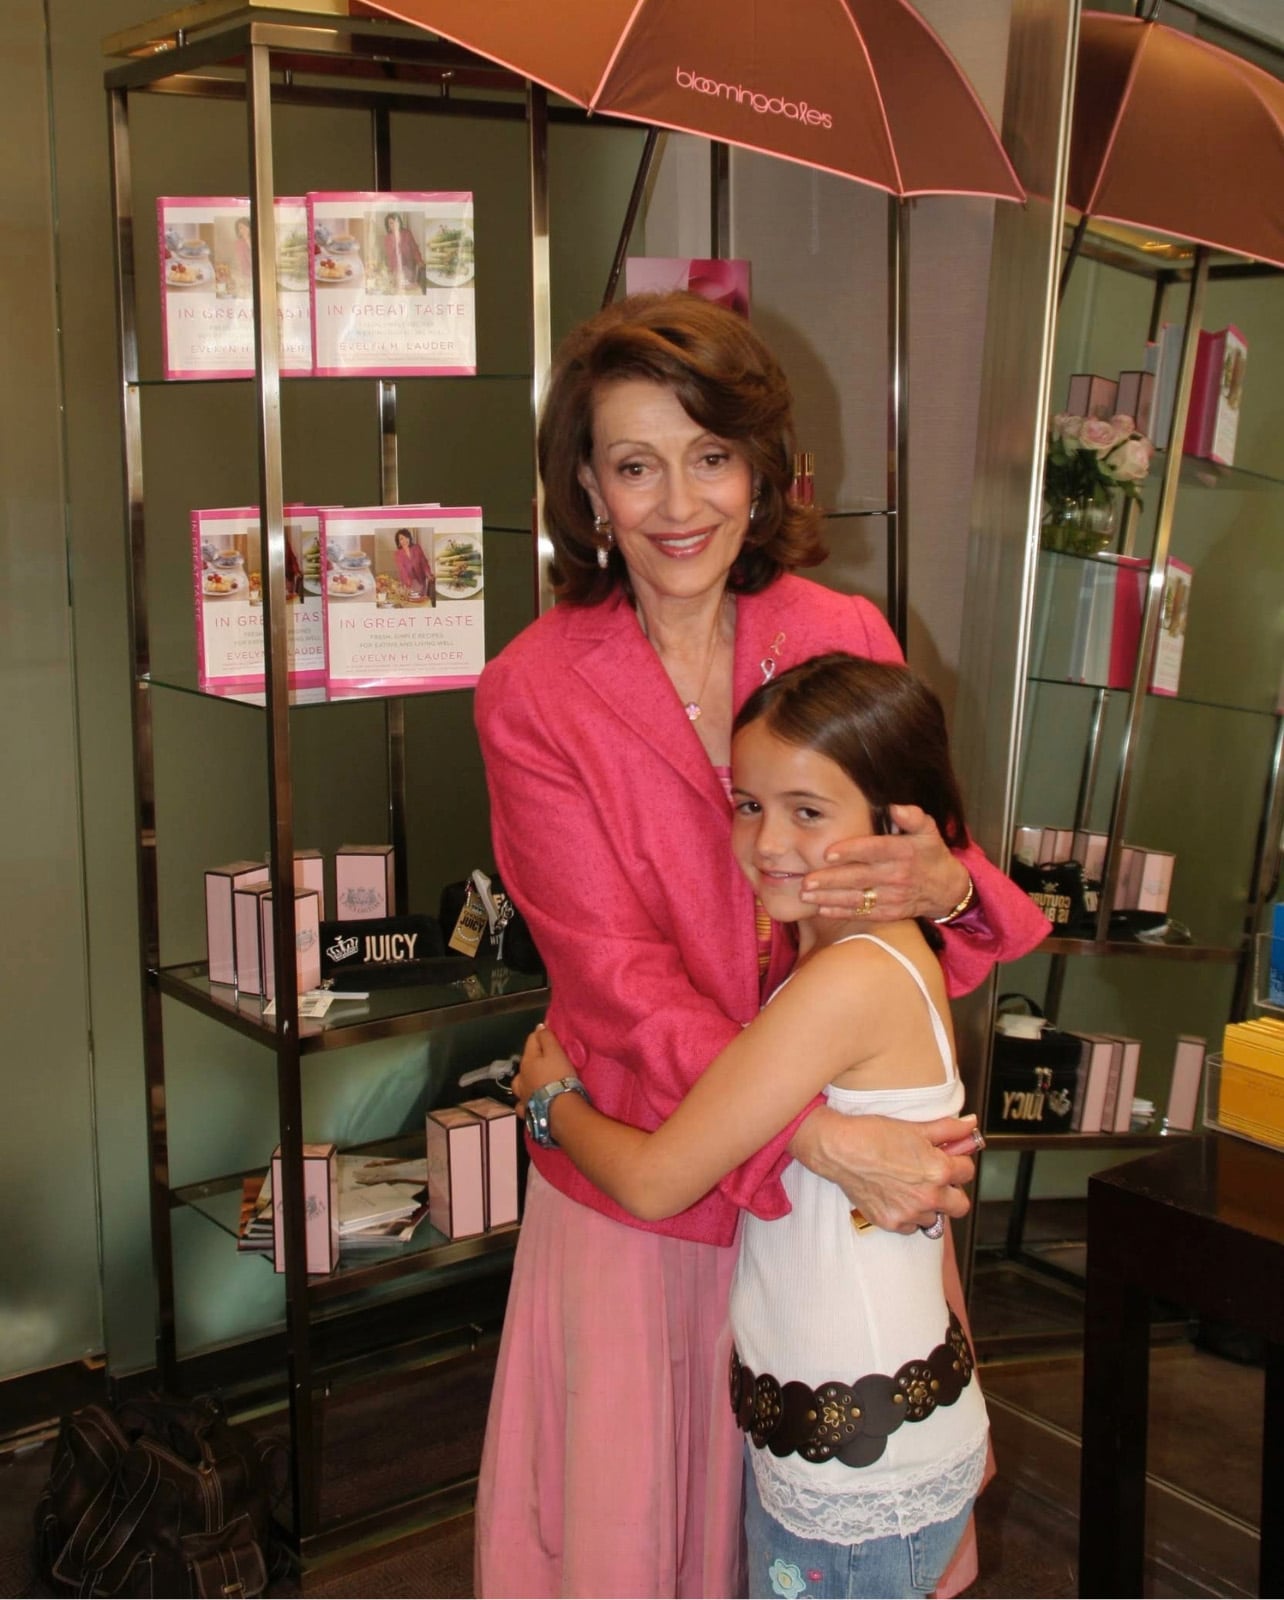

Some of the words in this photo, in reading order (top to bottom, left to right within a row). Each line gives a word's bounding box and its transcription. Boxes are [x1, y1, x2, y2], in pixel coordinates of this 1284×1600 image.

[178, 308, 194, 319] IN
[202, 308, 253, 319] GREA
[327, 304, 343, 316] IN
[352, 304, 405, 316] GREAT
[414, 304, 466, 316] TASTE
[407, 341, 455, 350] LAUDER
[215, 617, 230, 628] IN
[237, 615, 264, 627] GRE
[293, 611, 323, 623] TAS
[339, 618, 356, 629] IN
[363, 616, 417, 629] GREAT
[424, 615, 474, 627] TASTE
[227, 651, 264, 661] EVELY
[288, 646, 323, 656] LAUDE
[352, 653, 396, 663] EVELYN
[417, 652, 464, 661] LAUDER
[460, 914, 486, 933] JUICY
[363, 932, 418, 962] JUICY
